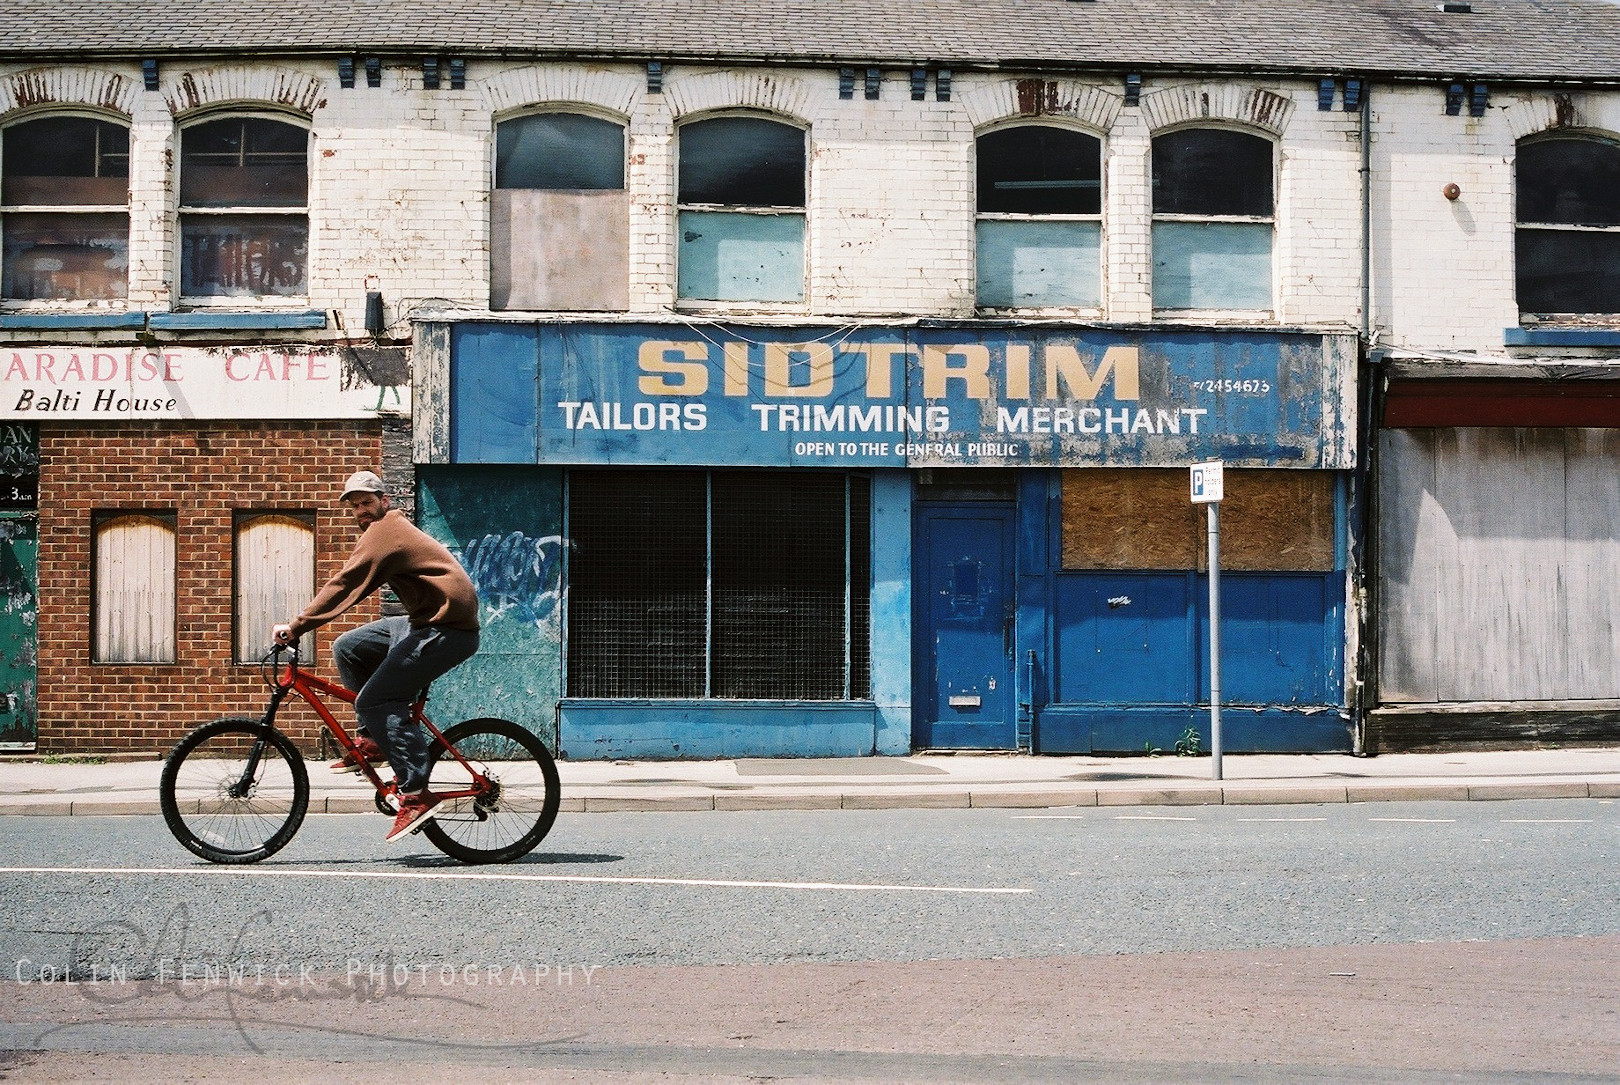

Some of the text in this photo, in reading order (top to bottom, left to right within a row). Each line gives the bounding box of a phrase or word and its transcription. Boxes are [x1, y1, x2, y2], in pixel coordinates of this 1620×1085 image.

[225, 352, 329, 381] CAFE
[638, 340, 1139, 401] SIDTRIM
[13, 389, 177, 412] Balti House
[558, 402, 1207, 434] TAILORS TRIMMING MERCHANT
[795, 442, 1018, 457] OPEN TO THE GENERAL PUBLIC
